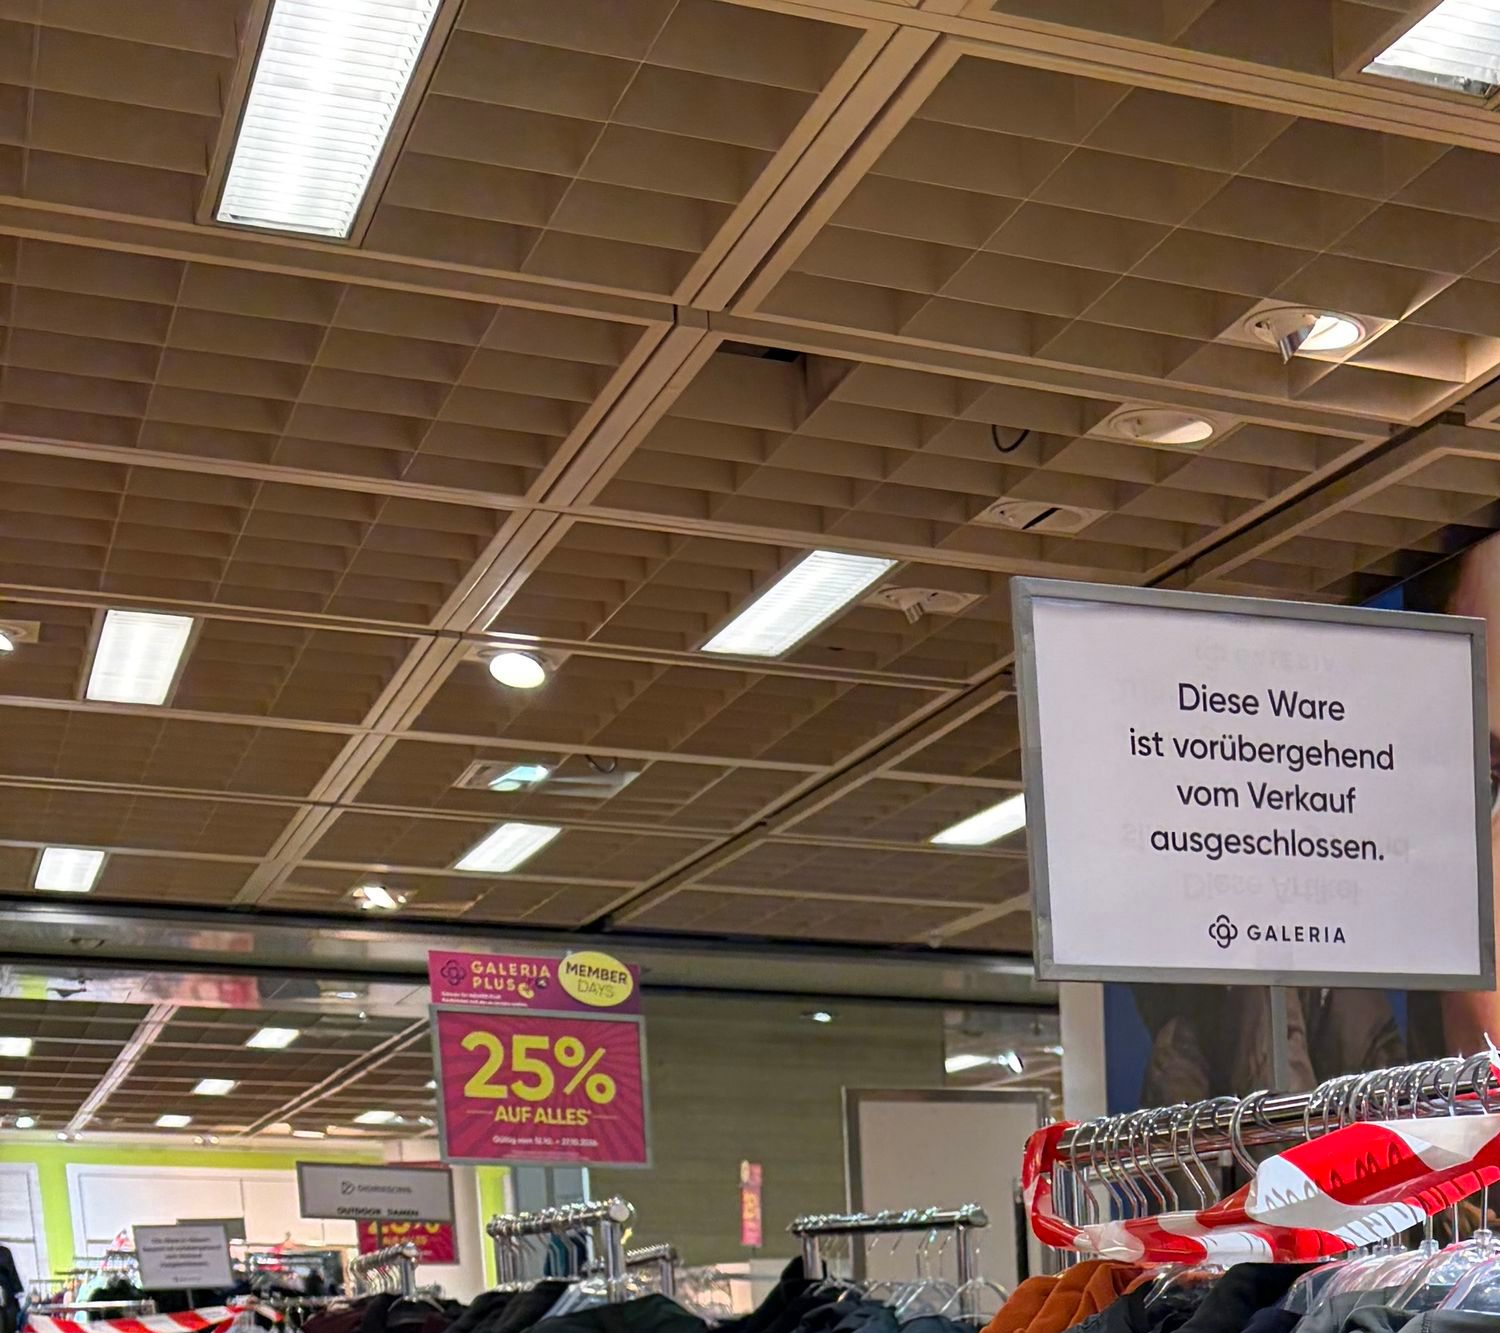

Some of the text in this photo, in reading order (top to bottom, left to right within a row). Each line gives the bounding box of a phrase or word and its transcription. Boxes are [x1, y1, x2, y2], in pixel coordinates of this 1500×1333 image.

[1178, 682, 1346, 721] Diese Ware
[1129, 728, 1395, 772] ist vorübergehend
[1176, 782, 1357, 814] vom Verkauf
[1150, 828, 1386, 861] ausgeschlossen.
[1247, 924, 1347, 945] GALERIA
[471, 960, 551, 979] GALERIA
[565, 960, 629, 985] MEMBER
[472, 976, 517, 992] PLUS
[577, 978, 615, 998] DAYS
[460, 1030, 616, 1105] 25%
[494, 1104, 532, 1123] AUF
